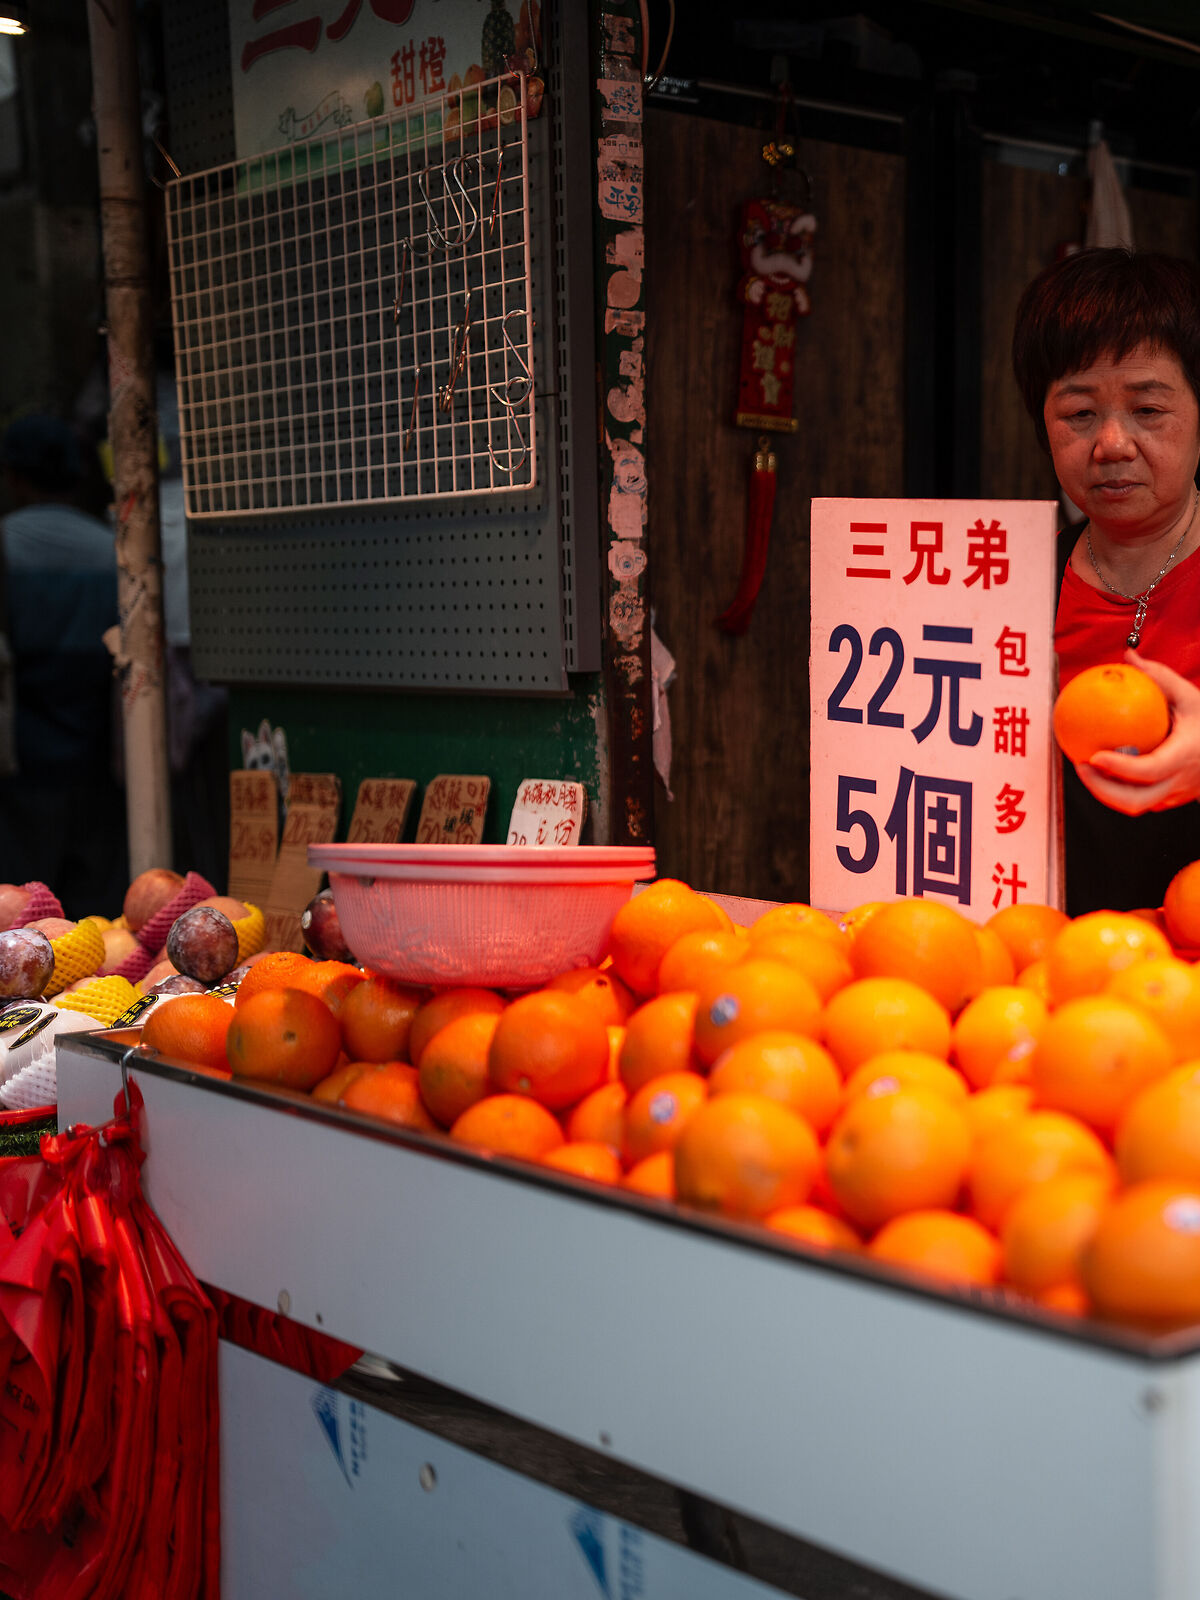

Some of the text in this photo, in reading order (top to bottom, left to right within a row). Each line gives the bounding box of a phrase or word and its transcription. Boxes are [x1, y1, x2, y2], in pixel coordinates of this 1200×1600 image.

[390, 36, 447, 107] 甜橙
[845, 518, 1010, 590] 三兄弟
[826, 623, 983, 747] 22元
[991, 625, 1030, 909] 包甜多汁
[835, 765, 974, 906] 5個
